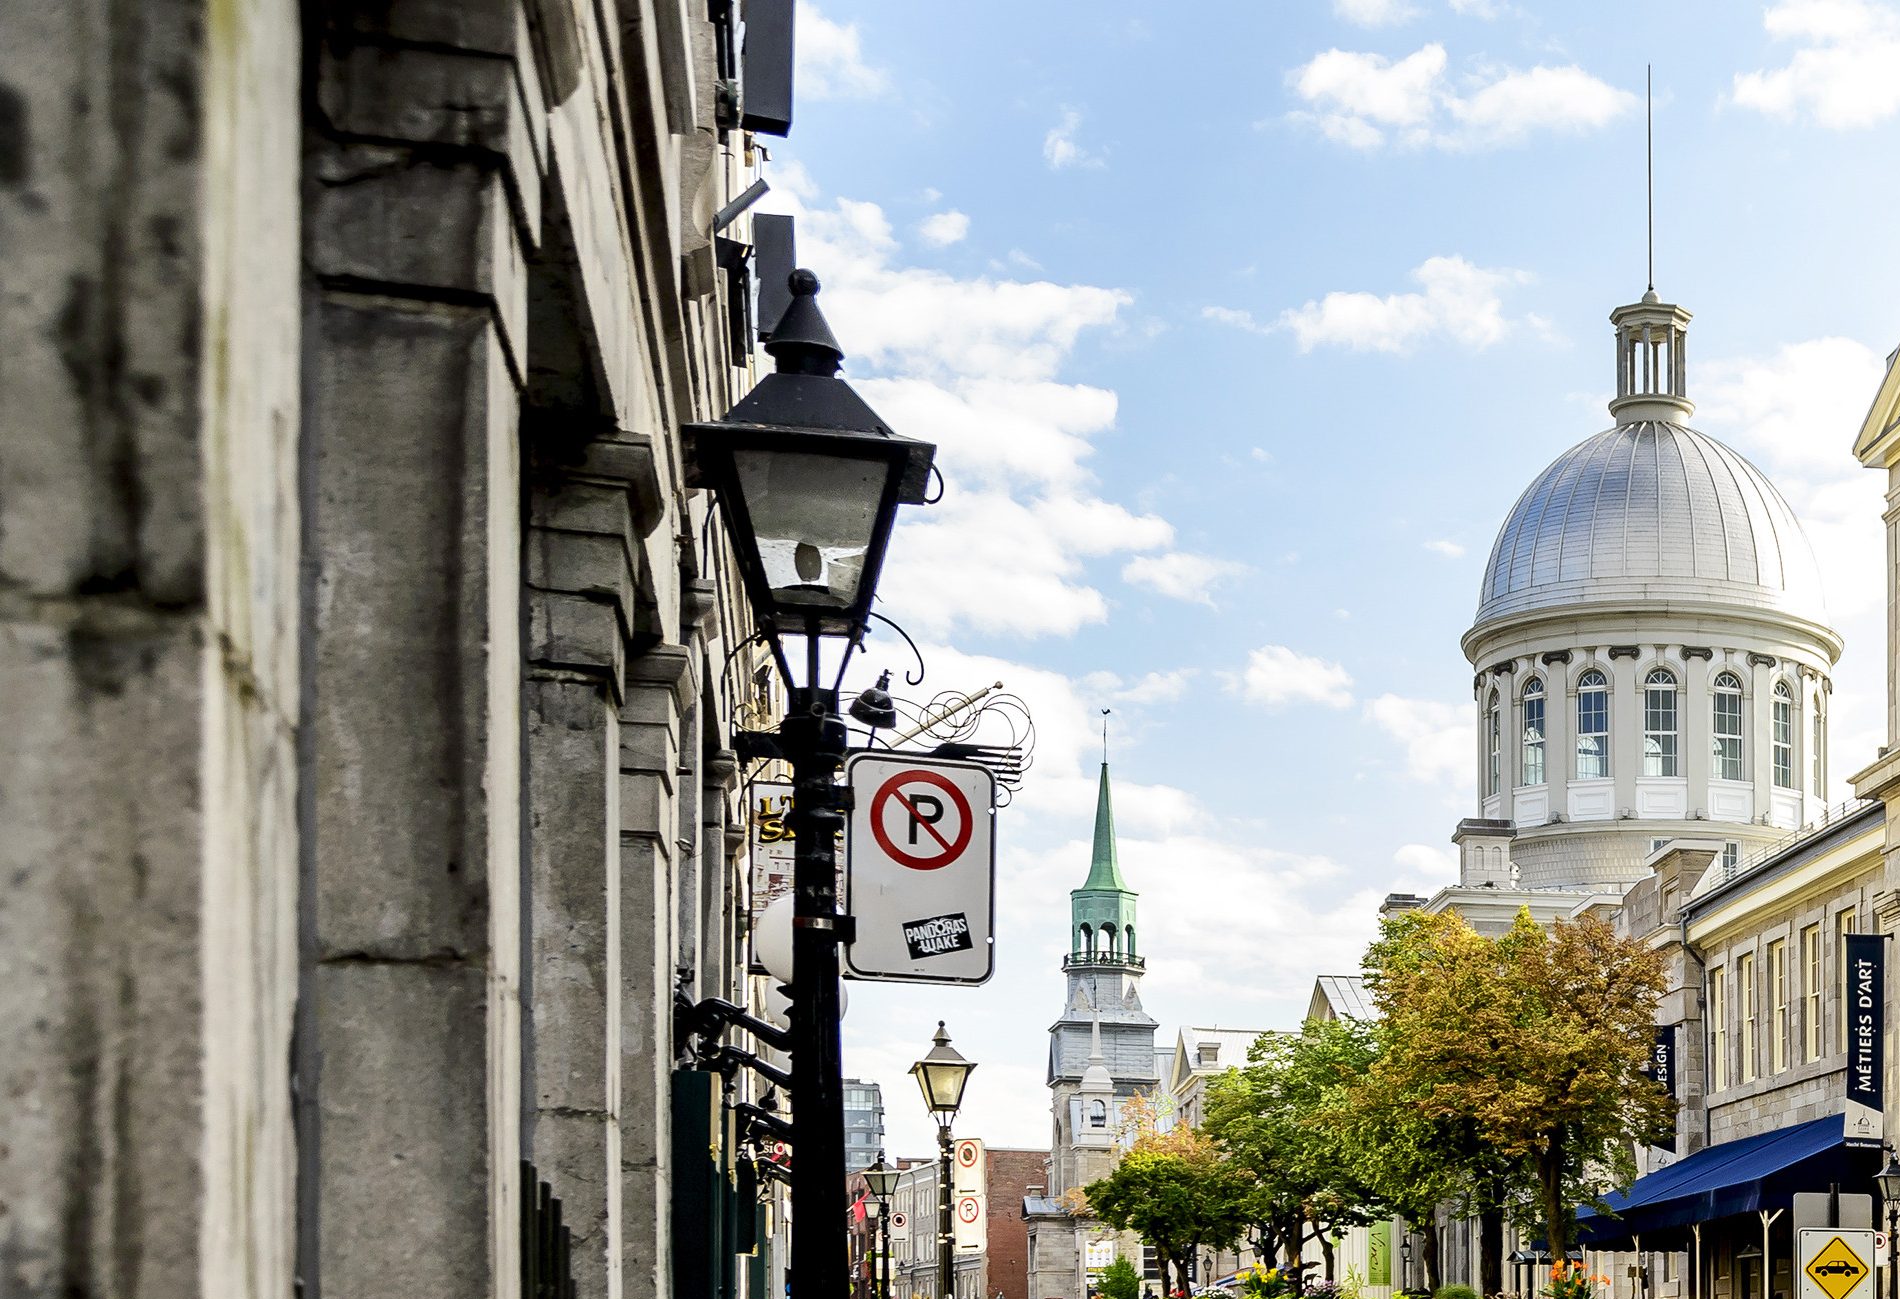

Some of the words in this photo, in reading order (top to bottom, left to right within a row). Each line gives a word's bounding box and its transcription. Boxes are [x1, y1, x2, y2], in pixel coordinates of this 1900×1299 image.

[918, 933, 960, 953] WAKE
[1857, 958, 1872, 1008] D'ART
[1855, 1014, 1872, 1092] MÉTIERS
